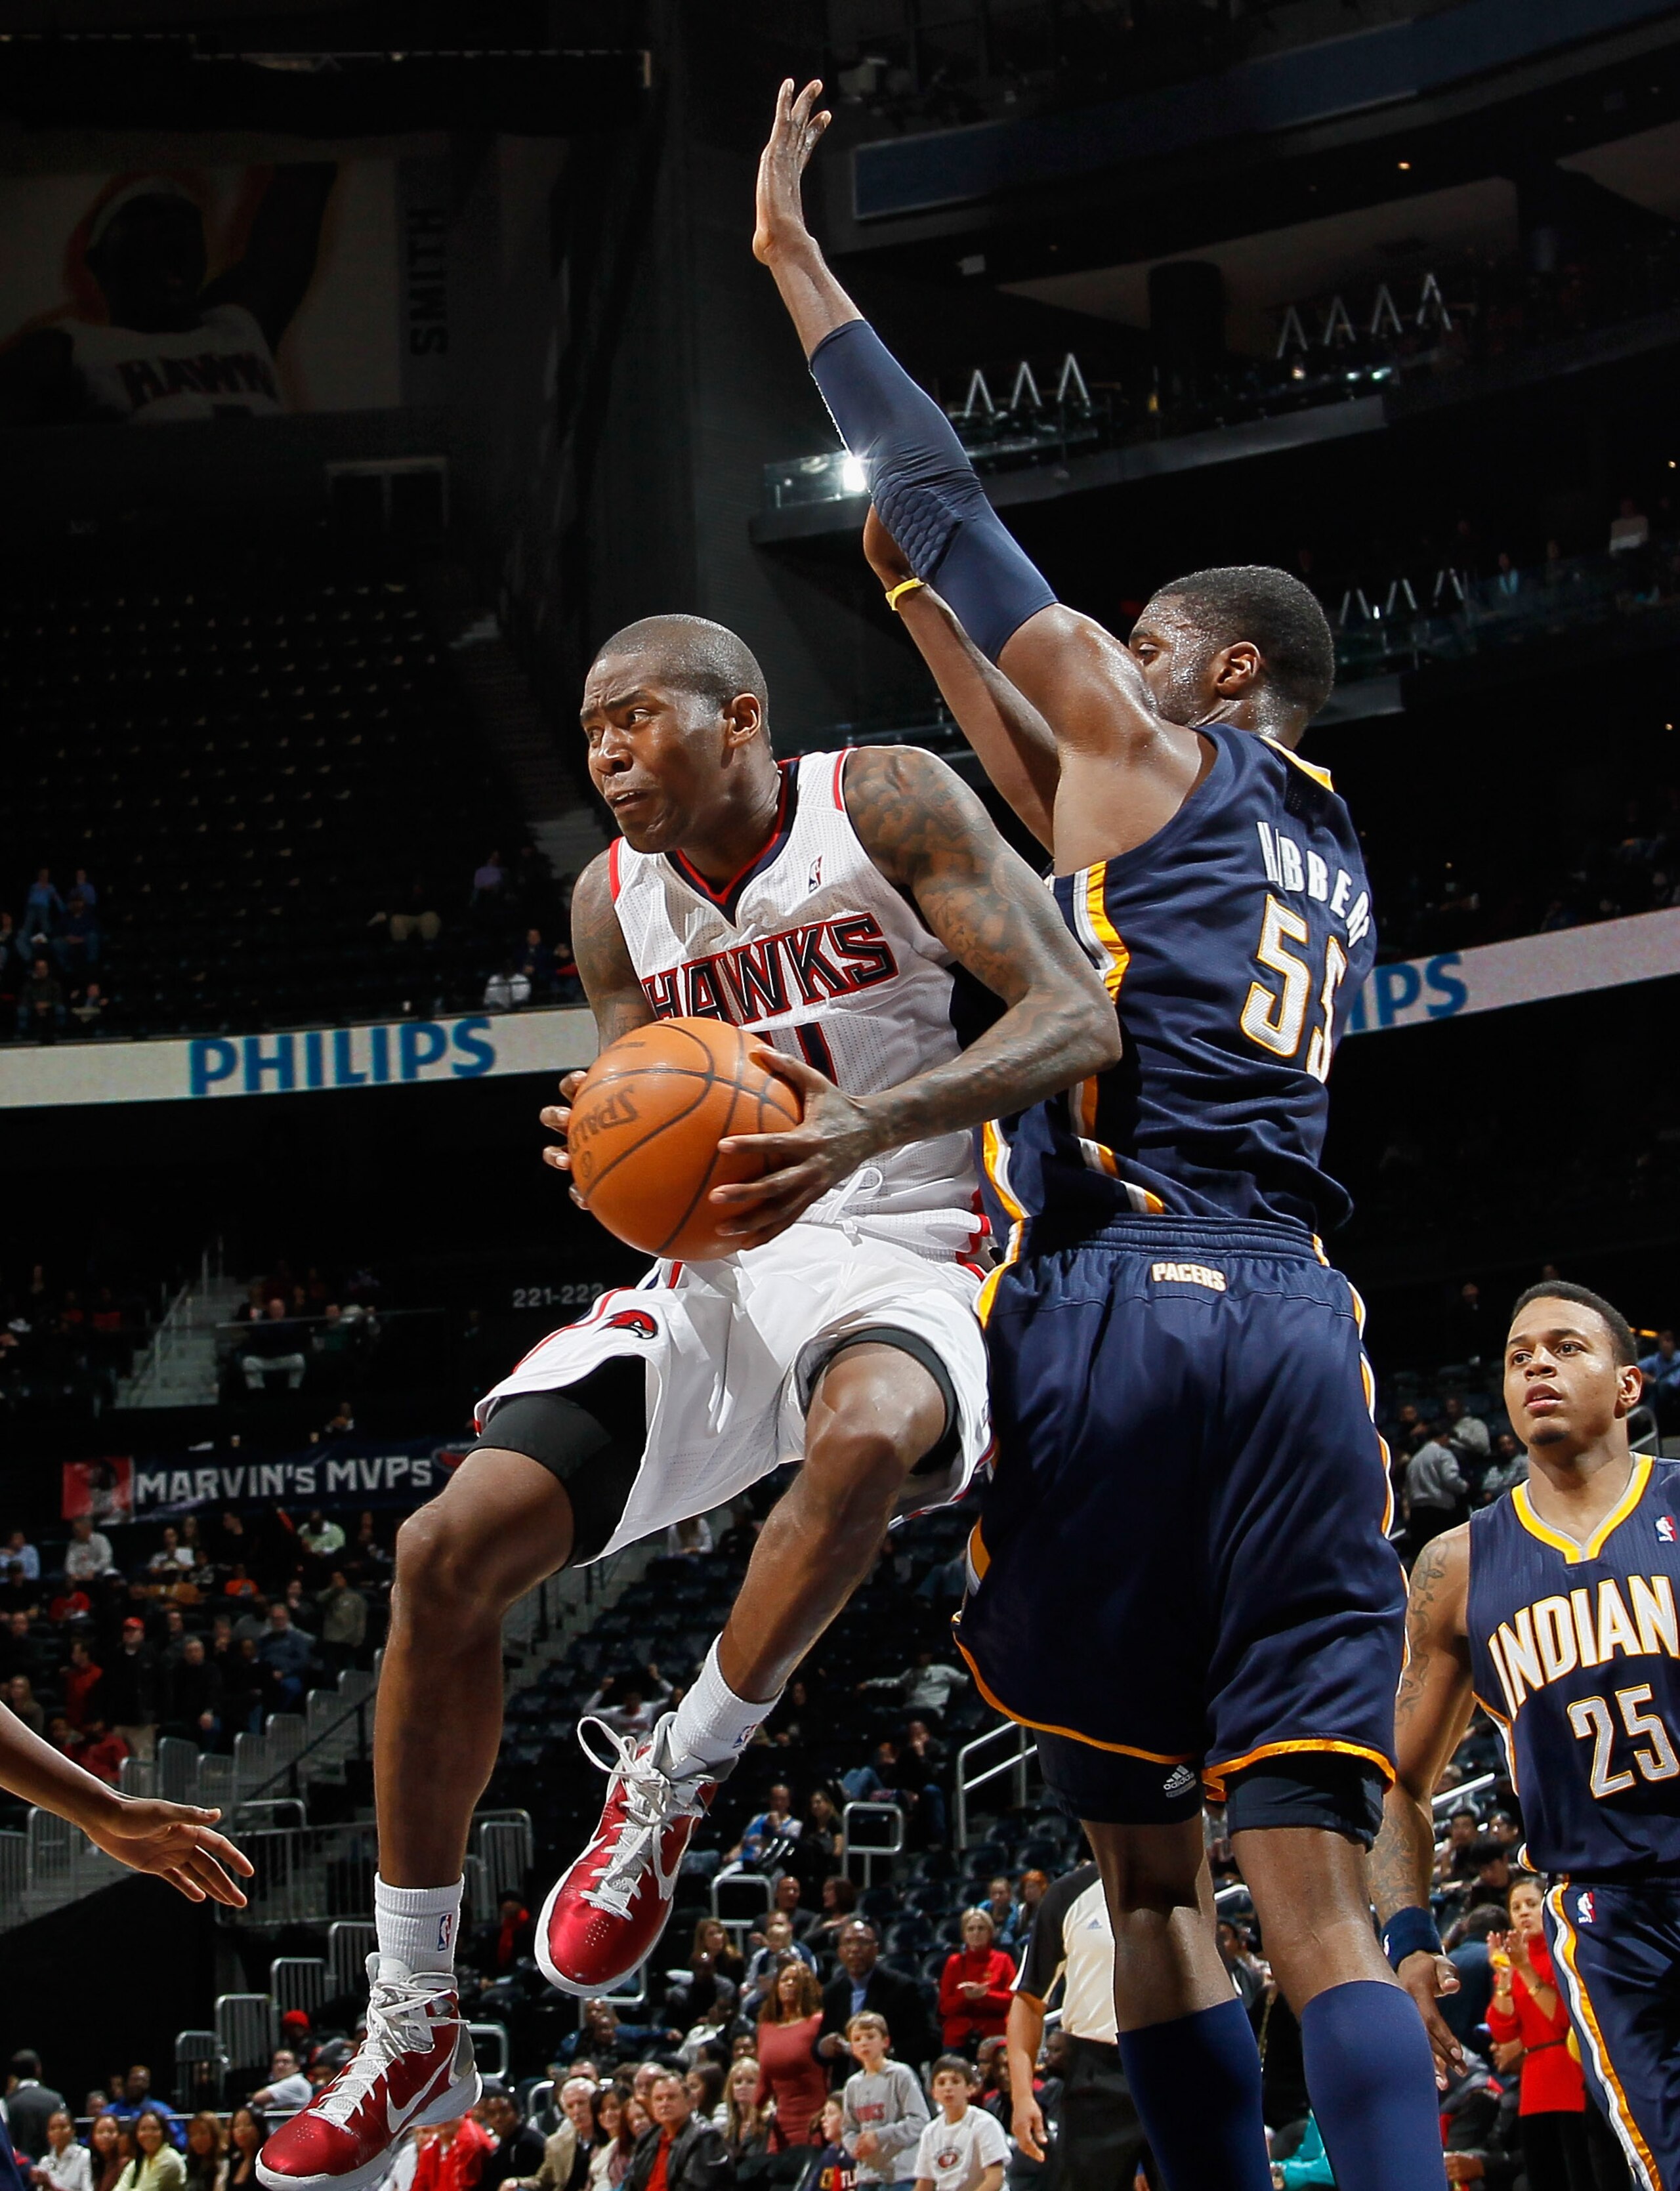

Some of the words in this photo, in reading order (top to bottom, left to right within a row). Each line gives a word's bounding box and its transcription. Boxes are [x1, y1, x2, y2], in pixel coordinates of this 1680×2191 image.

[408, 209, 448, 356] SMITH
[641, 912, 899, 1027] HAWKS
[1239, 894, 1348, 1084] 55
[191, 1016, 495, 1095] PHILIPS
[1150, 1261, 1227, 1293] PACERS
[1566, 1683, 1680, 1799] 25
